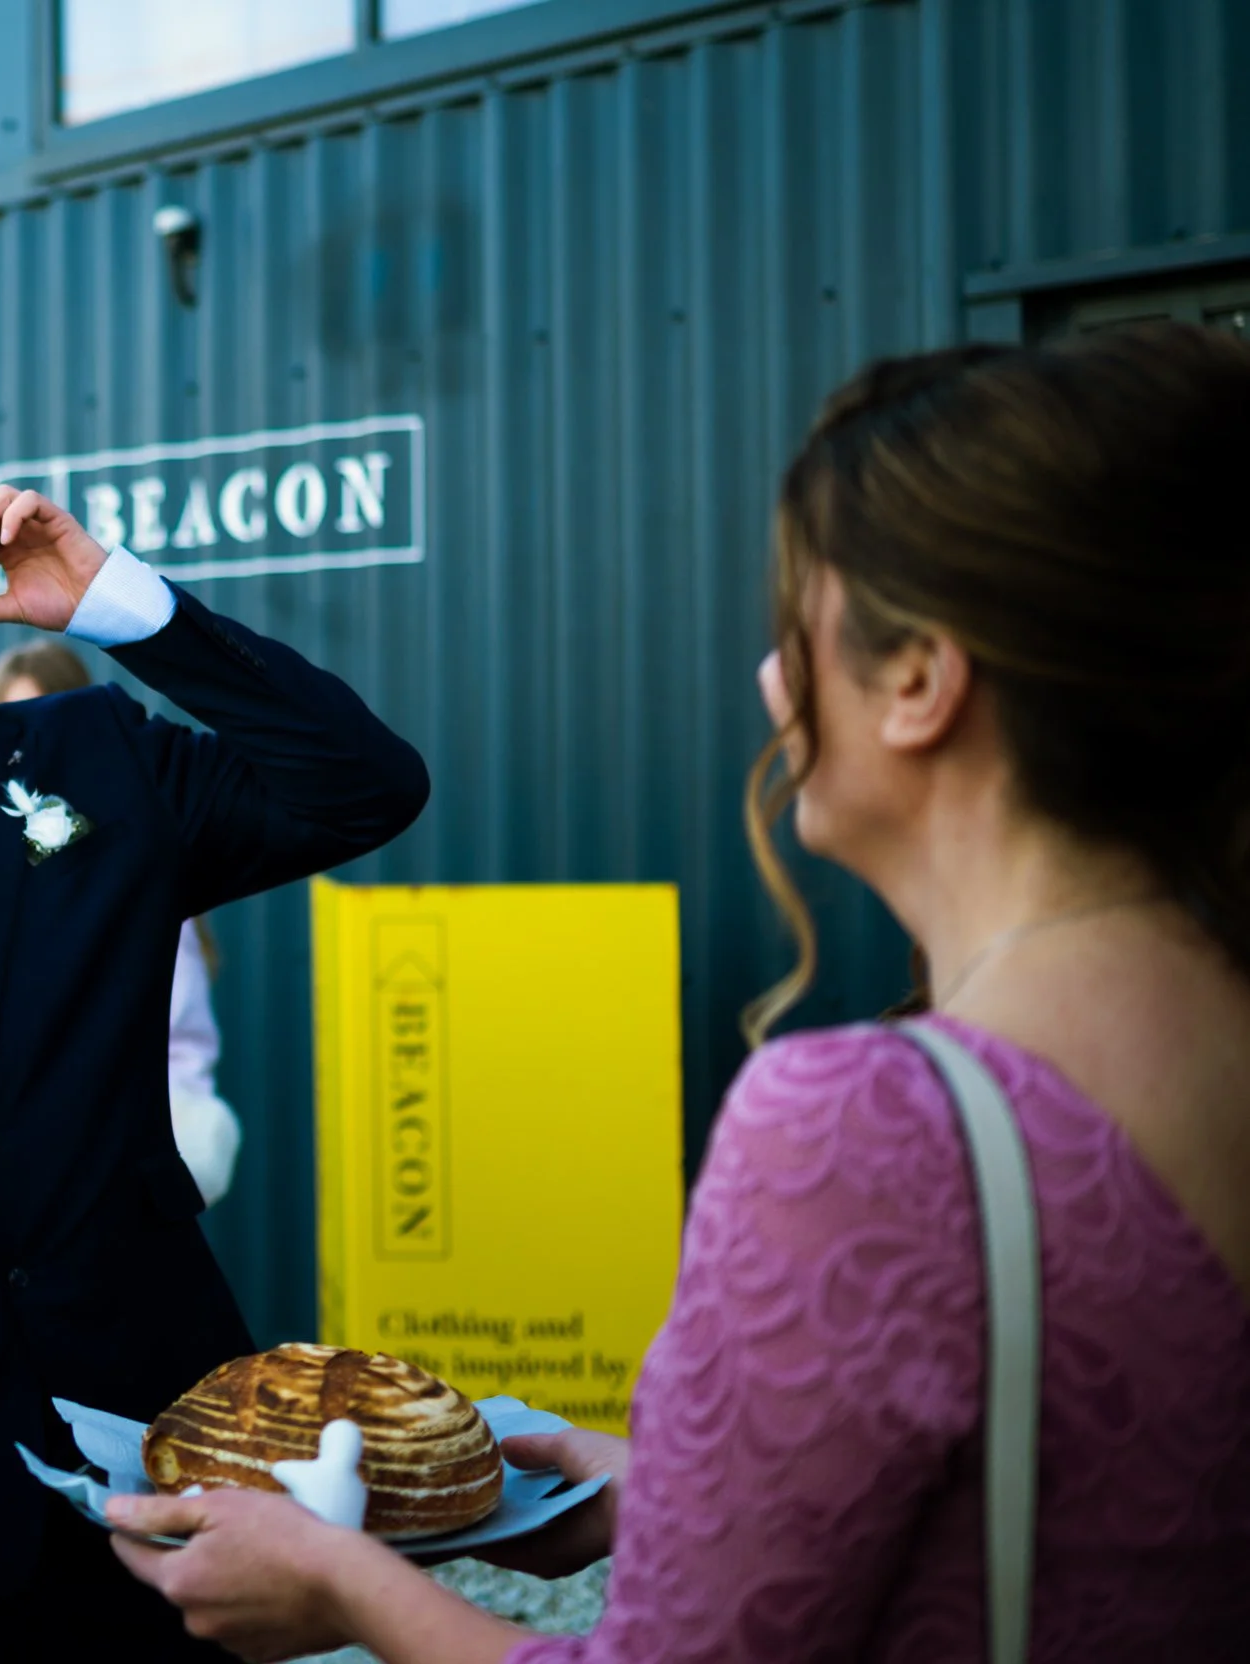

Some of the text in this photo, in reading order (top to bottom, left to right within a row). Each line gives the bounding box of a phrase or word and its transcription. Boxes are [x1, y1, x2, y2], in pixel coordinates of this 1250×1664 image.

[83, 450, 393, 553] BEACON
[391, 1002, 434, 1239] BEACON
[377, 1309, 584, 1345] Clothing and
